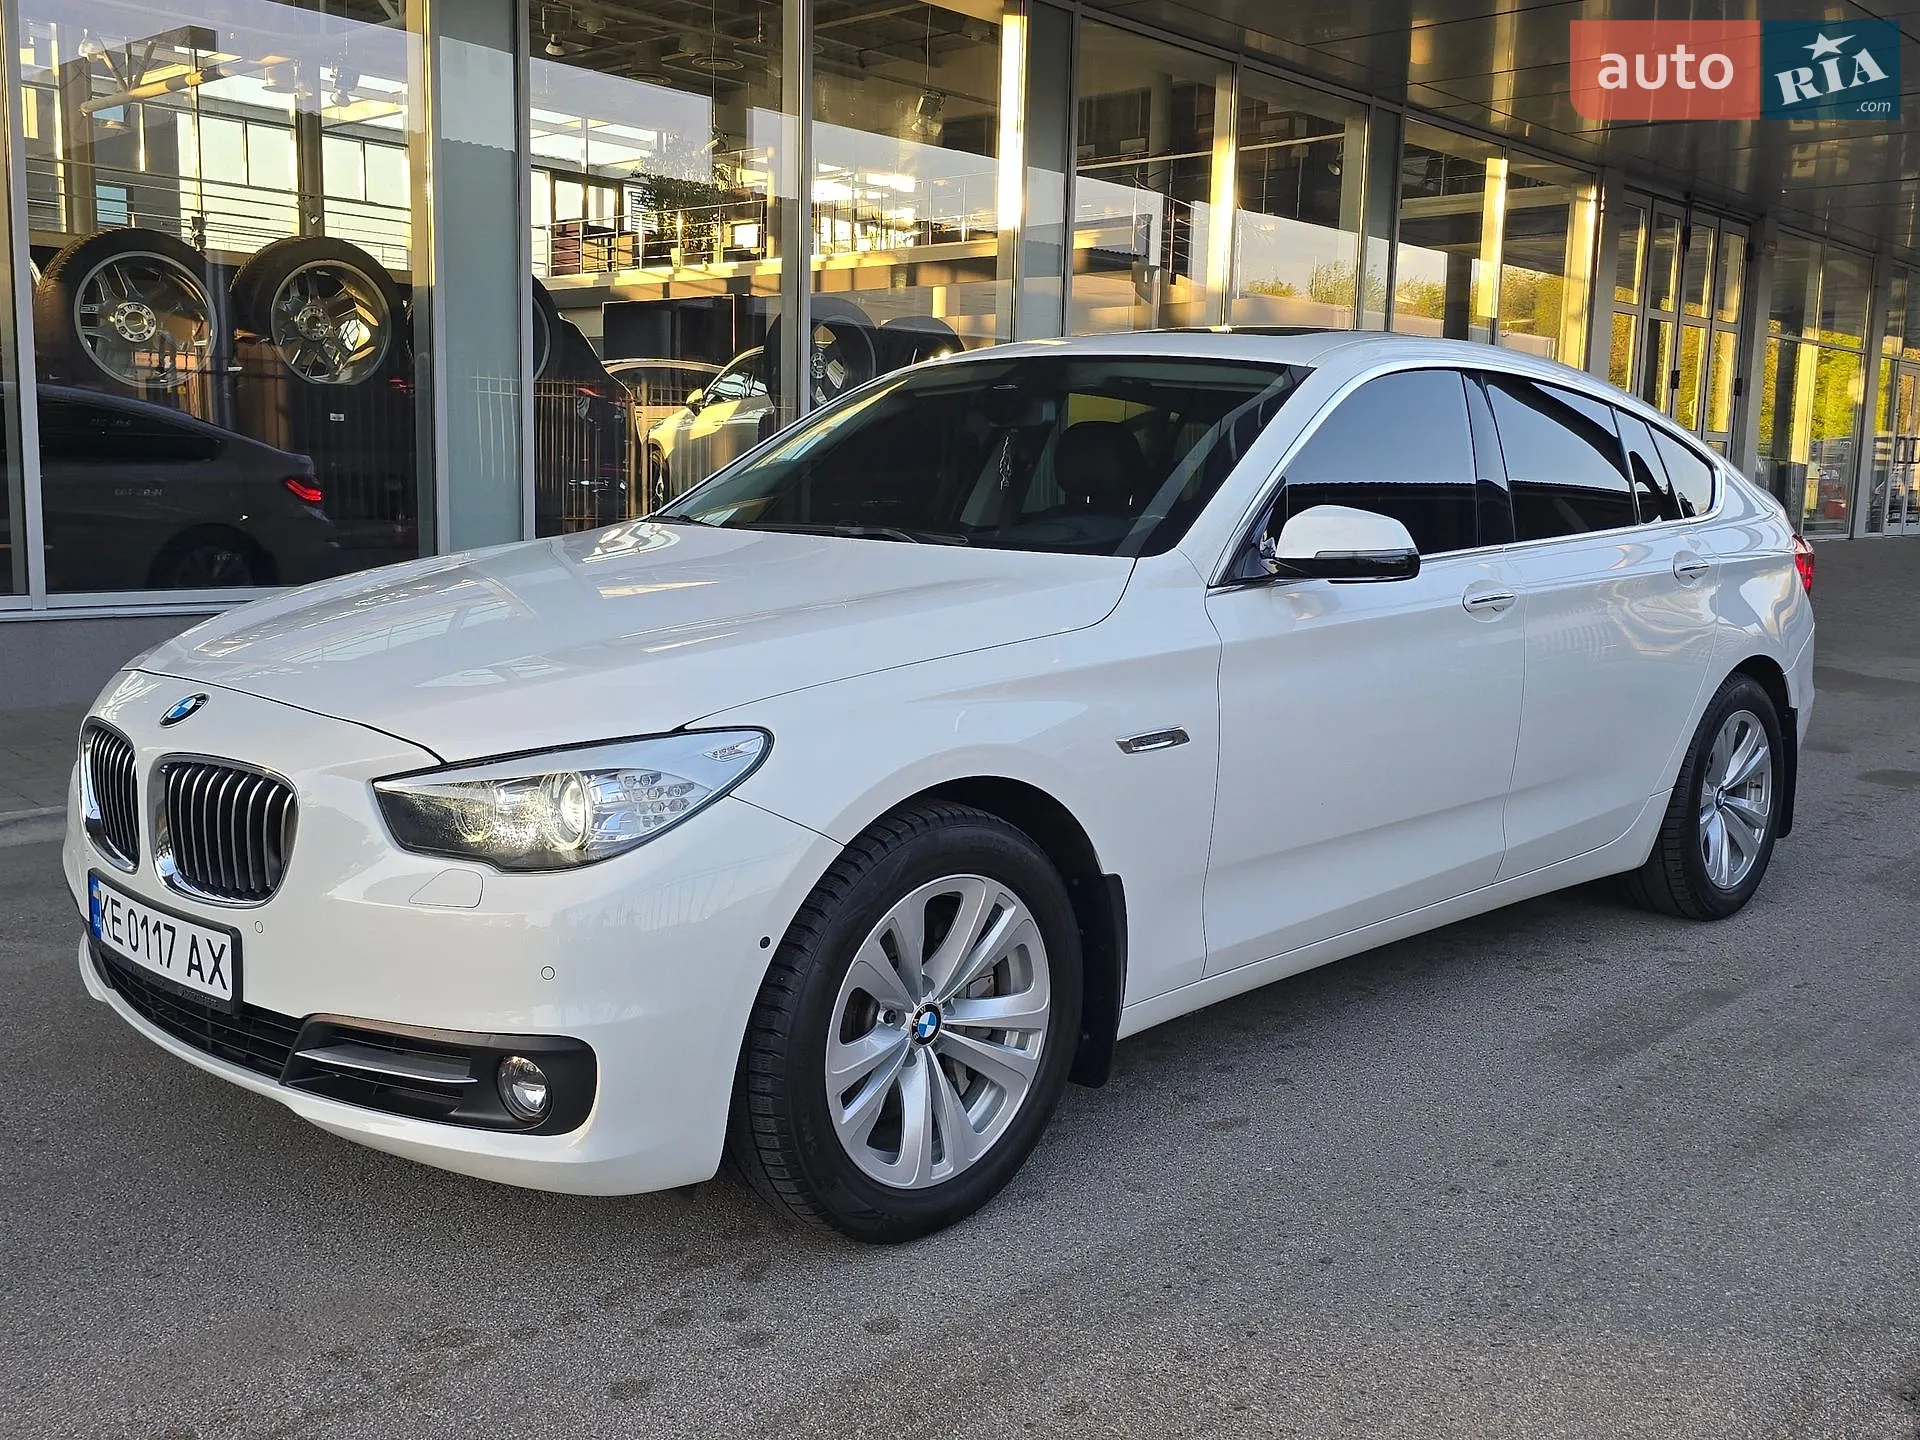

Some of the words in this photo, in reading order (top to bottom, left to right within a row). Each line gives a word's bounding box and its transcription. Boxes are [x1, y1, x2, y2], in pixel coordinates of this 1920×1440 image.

[99, 891, 123, 946] KE
[128, 908, 176, 968] 0117
[187, 934, 228, 990] AX
